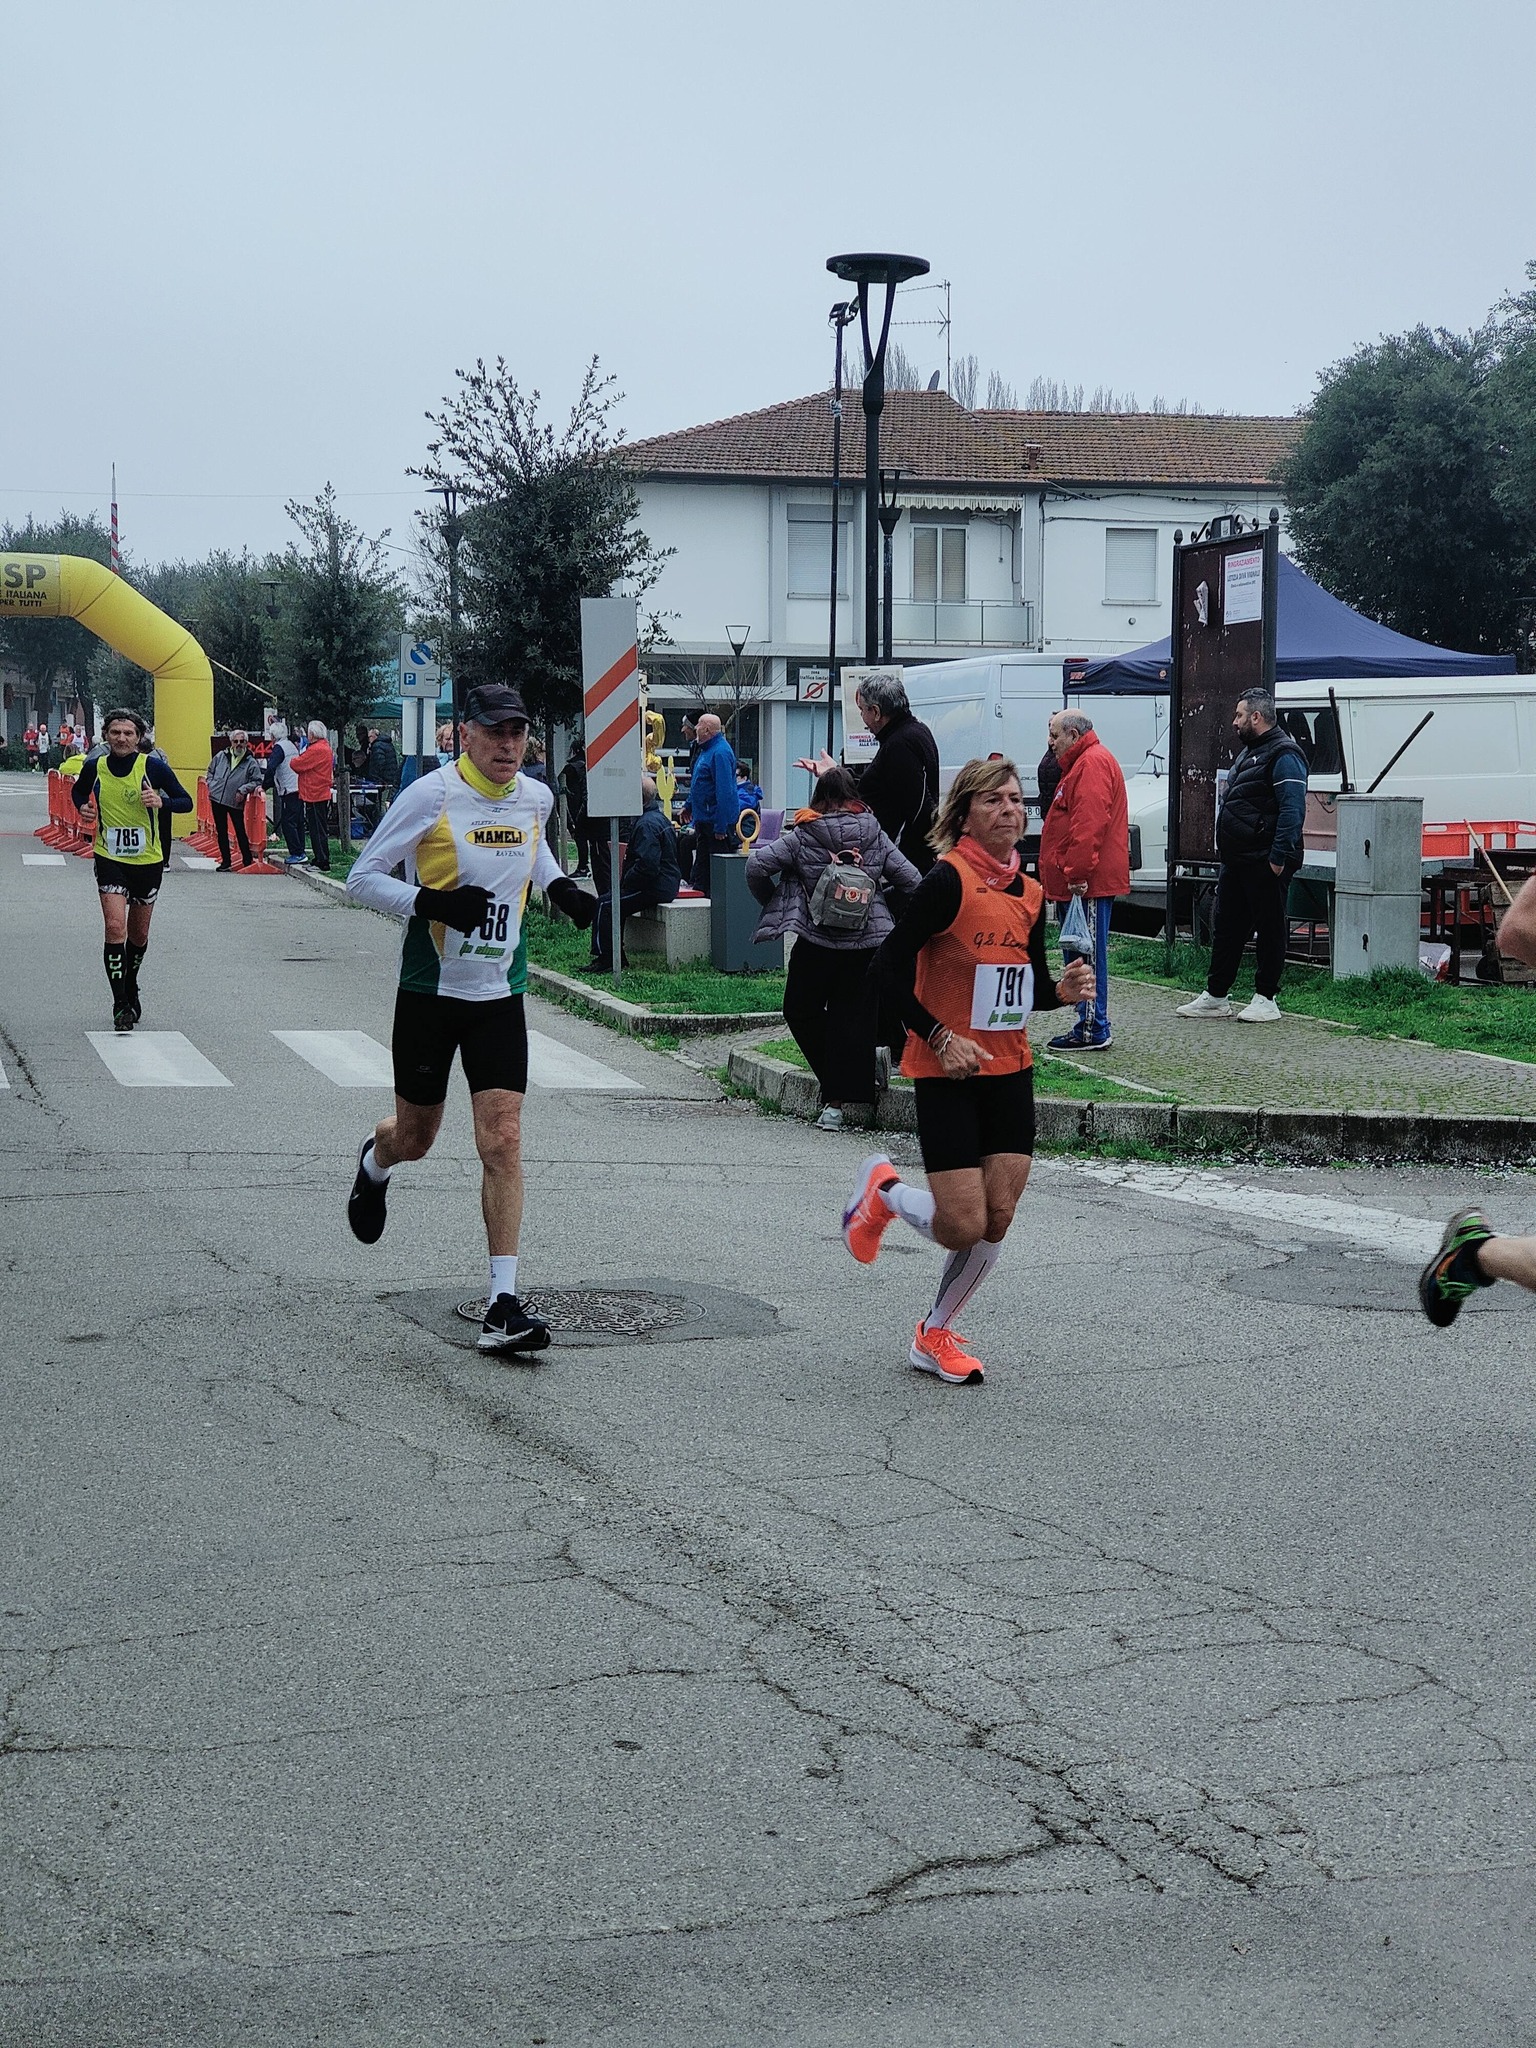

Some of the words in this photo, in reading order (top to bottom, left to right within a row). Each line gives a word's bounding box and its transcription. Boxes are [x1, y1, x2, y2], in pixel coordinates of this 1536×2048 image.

[6, 590, 47, 600] ITALIANA
[115, 828, 139, 847] 785
[474, 830, 522, 844] MAMELI
[995, 967, 1025, 1007] 791
